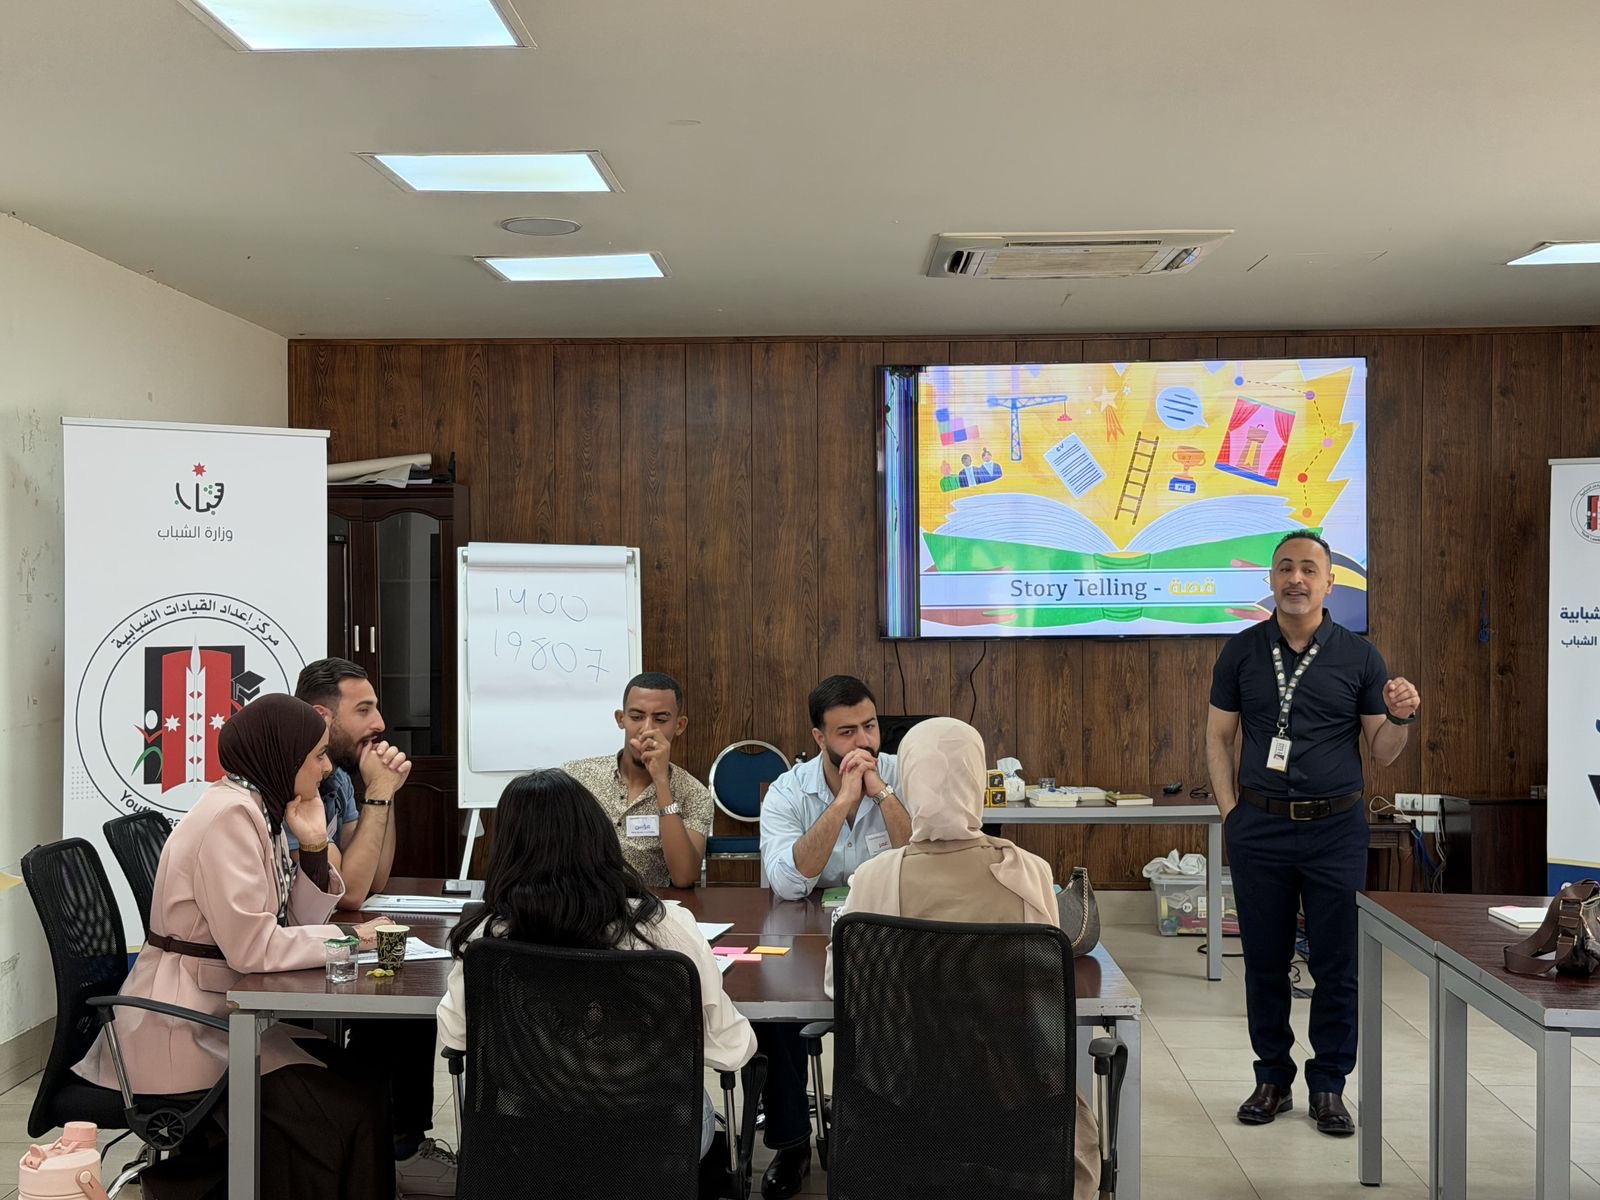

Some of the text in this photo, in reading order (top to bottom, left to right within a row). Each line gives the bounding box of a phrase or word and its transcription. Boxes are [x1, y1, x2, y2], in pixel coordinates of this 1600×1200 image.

[157, 523, 233, 541] وزارة الشباب
[1010, 579, 1068, 601] Story
[1073, 577, 1148, 600] Telling
[1168, 577, 1217, 596] قصة
[495, 587, 588, 622] 1400
[111, 599, 280, 649] مركز إعداد القيادات الشبابية
[1560, 635, 1598, 649] الشباب
[494, 629, 609, 683] 19807
[119, 789, 152, 814] You
